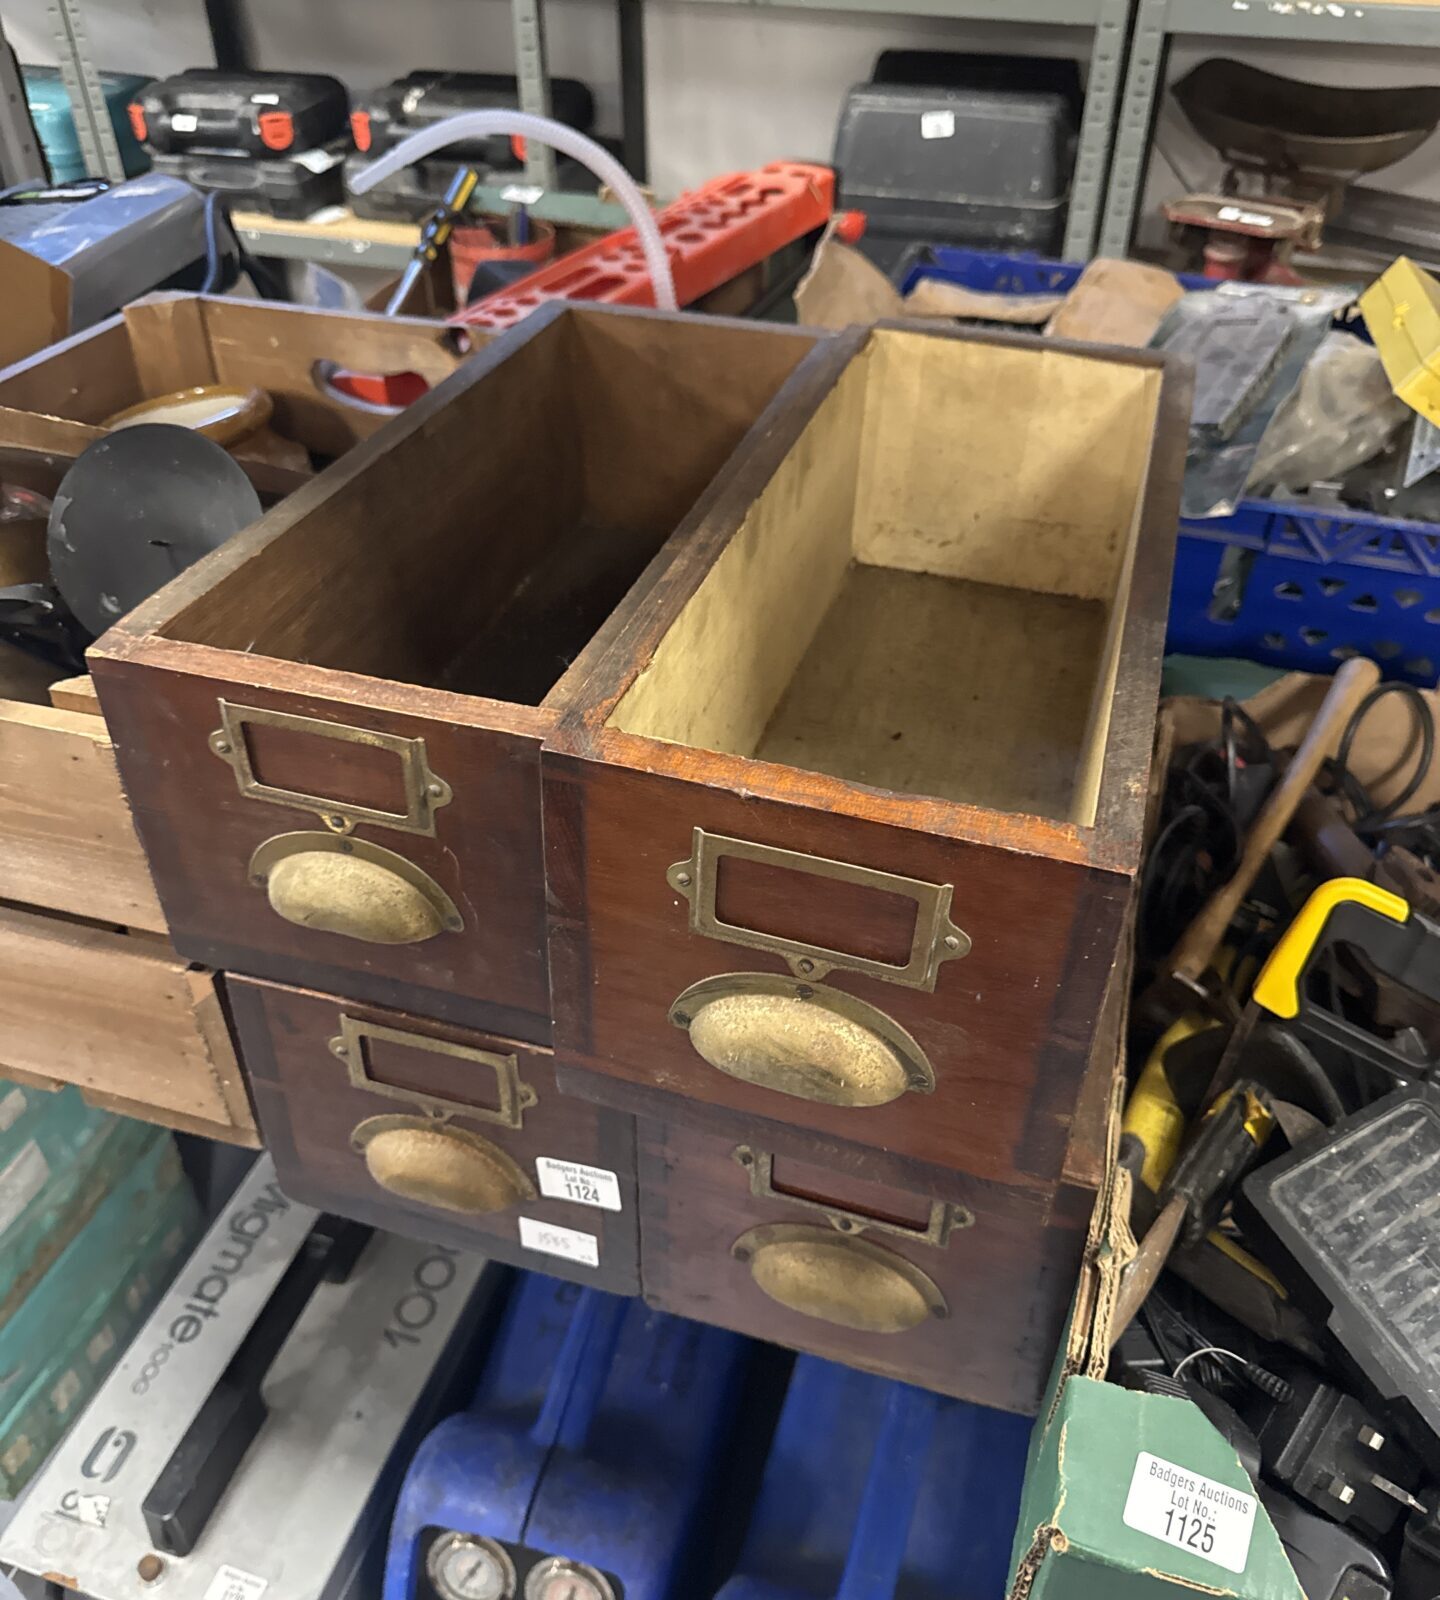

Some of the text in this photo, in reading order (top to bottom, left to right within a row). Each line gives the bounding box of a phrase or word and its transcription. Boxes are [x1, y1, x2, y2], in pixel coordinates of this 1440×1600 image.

[565, 1174, 577, 1184] Lot
[565, 1183, 600, 1203] 1124
[383, 1244, 462, 1348] 100
[1149, 1460, 1249, 1515] Badgers Auctions
[1170, 1490, 1217, 1522] Lot No.:
[1165, 1508, 1217, 1554] 1125
